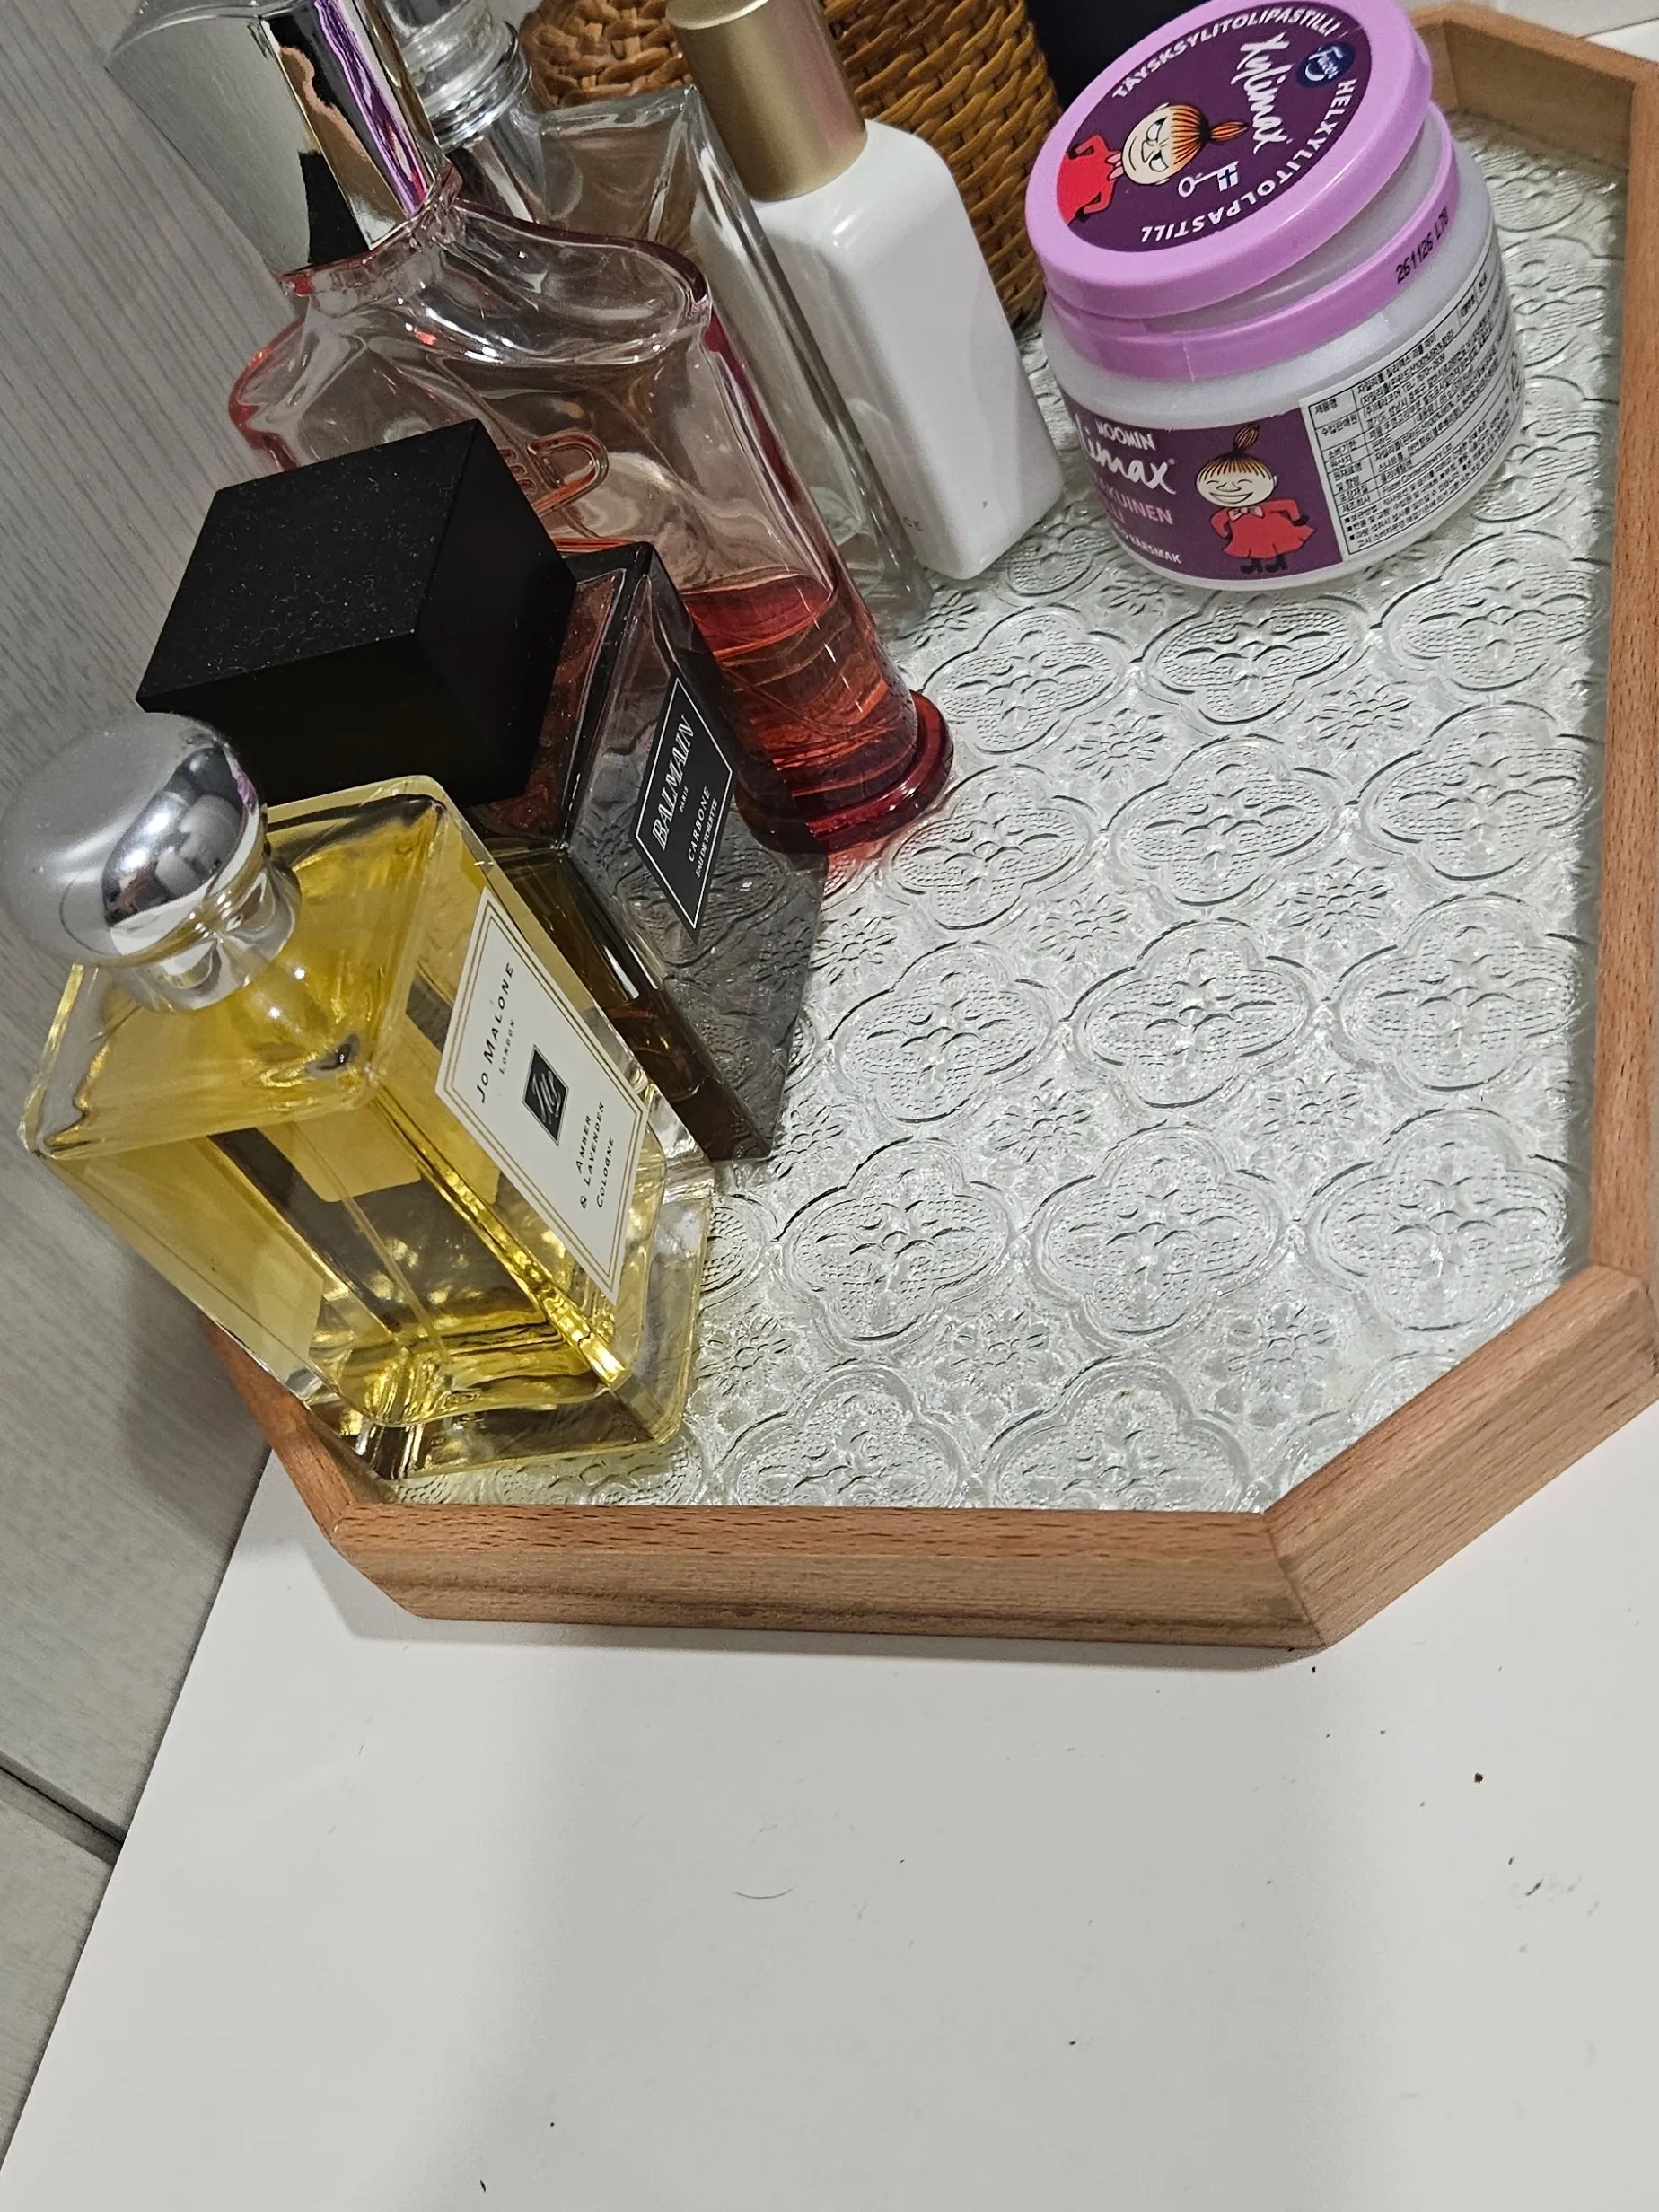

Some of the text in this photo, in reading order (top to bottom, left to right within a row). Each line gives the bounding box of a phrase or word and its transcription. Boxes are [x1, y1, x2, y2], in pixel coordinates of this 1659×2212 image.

[1141, 78, 1357, 243] HELXYLITOLPASTILL
[1395, 232, 1434, 284] 261126
[1094, 418, 1156, 452] MOOMIN
[652, 715, 695, 851] BALMAIN
[679, 786, 689, 813] PARIS
[688, 786, 711, 863] CARBONE
[476, 961, 514, 1104] JO MALONE
[499, 1018, 516, 1075] LONDON
[575, 1115, 592, 1174] AMBER
[584, 1102, 605, 1187] LAVENDER
[596, 1136, 614, 1209] COLOGNE
